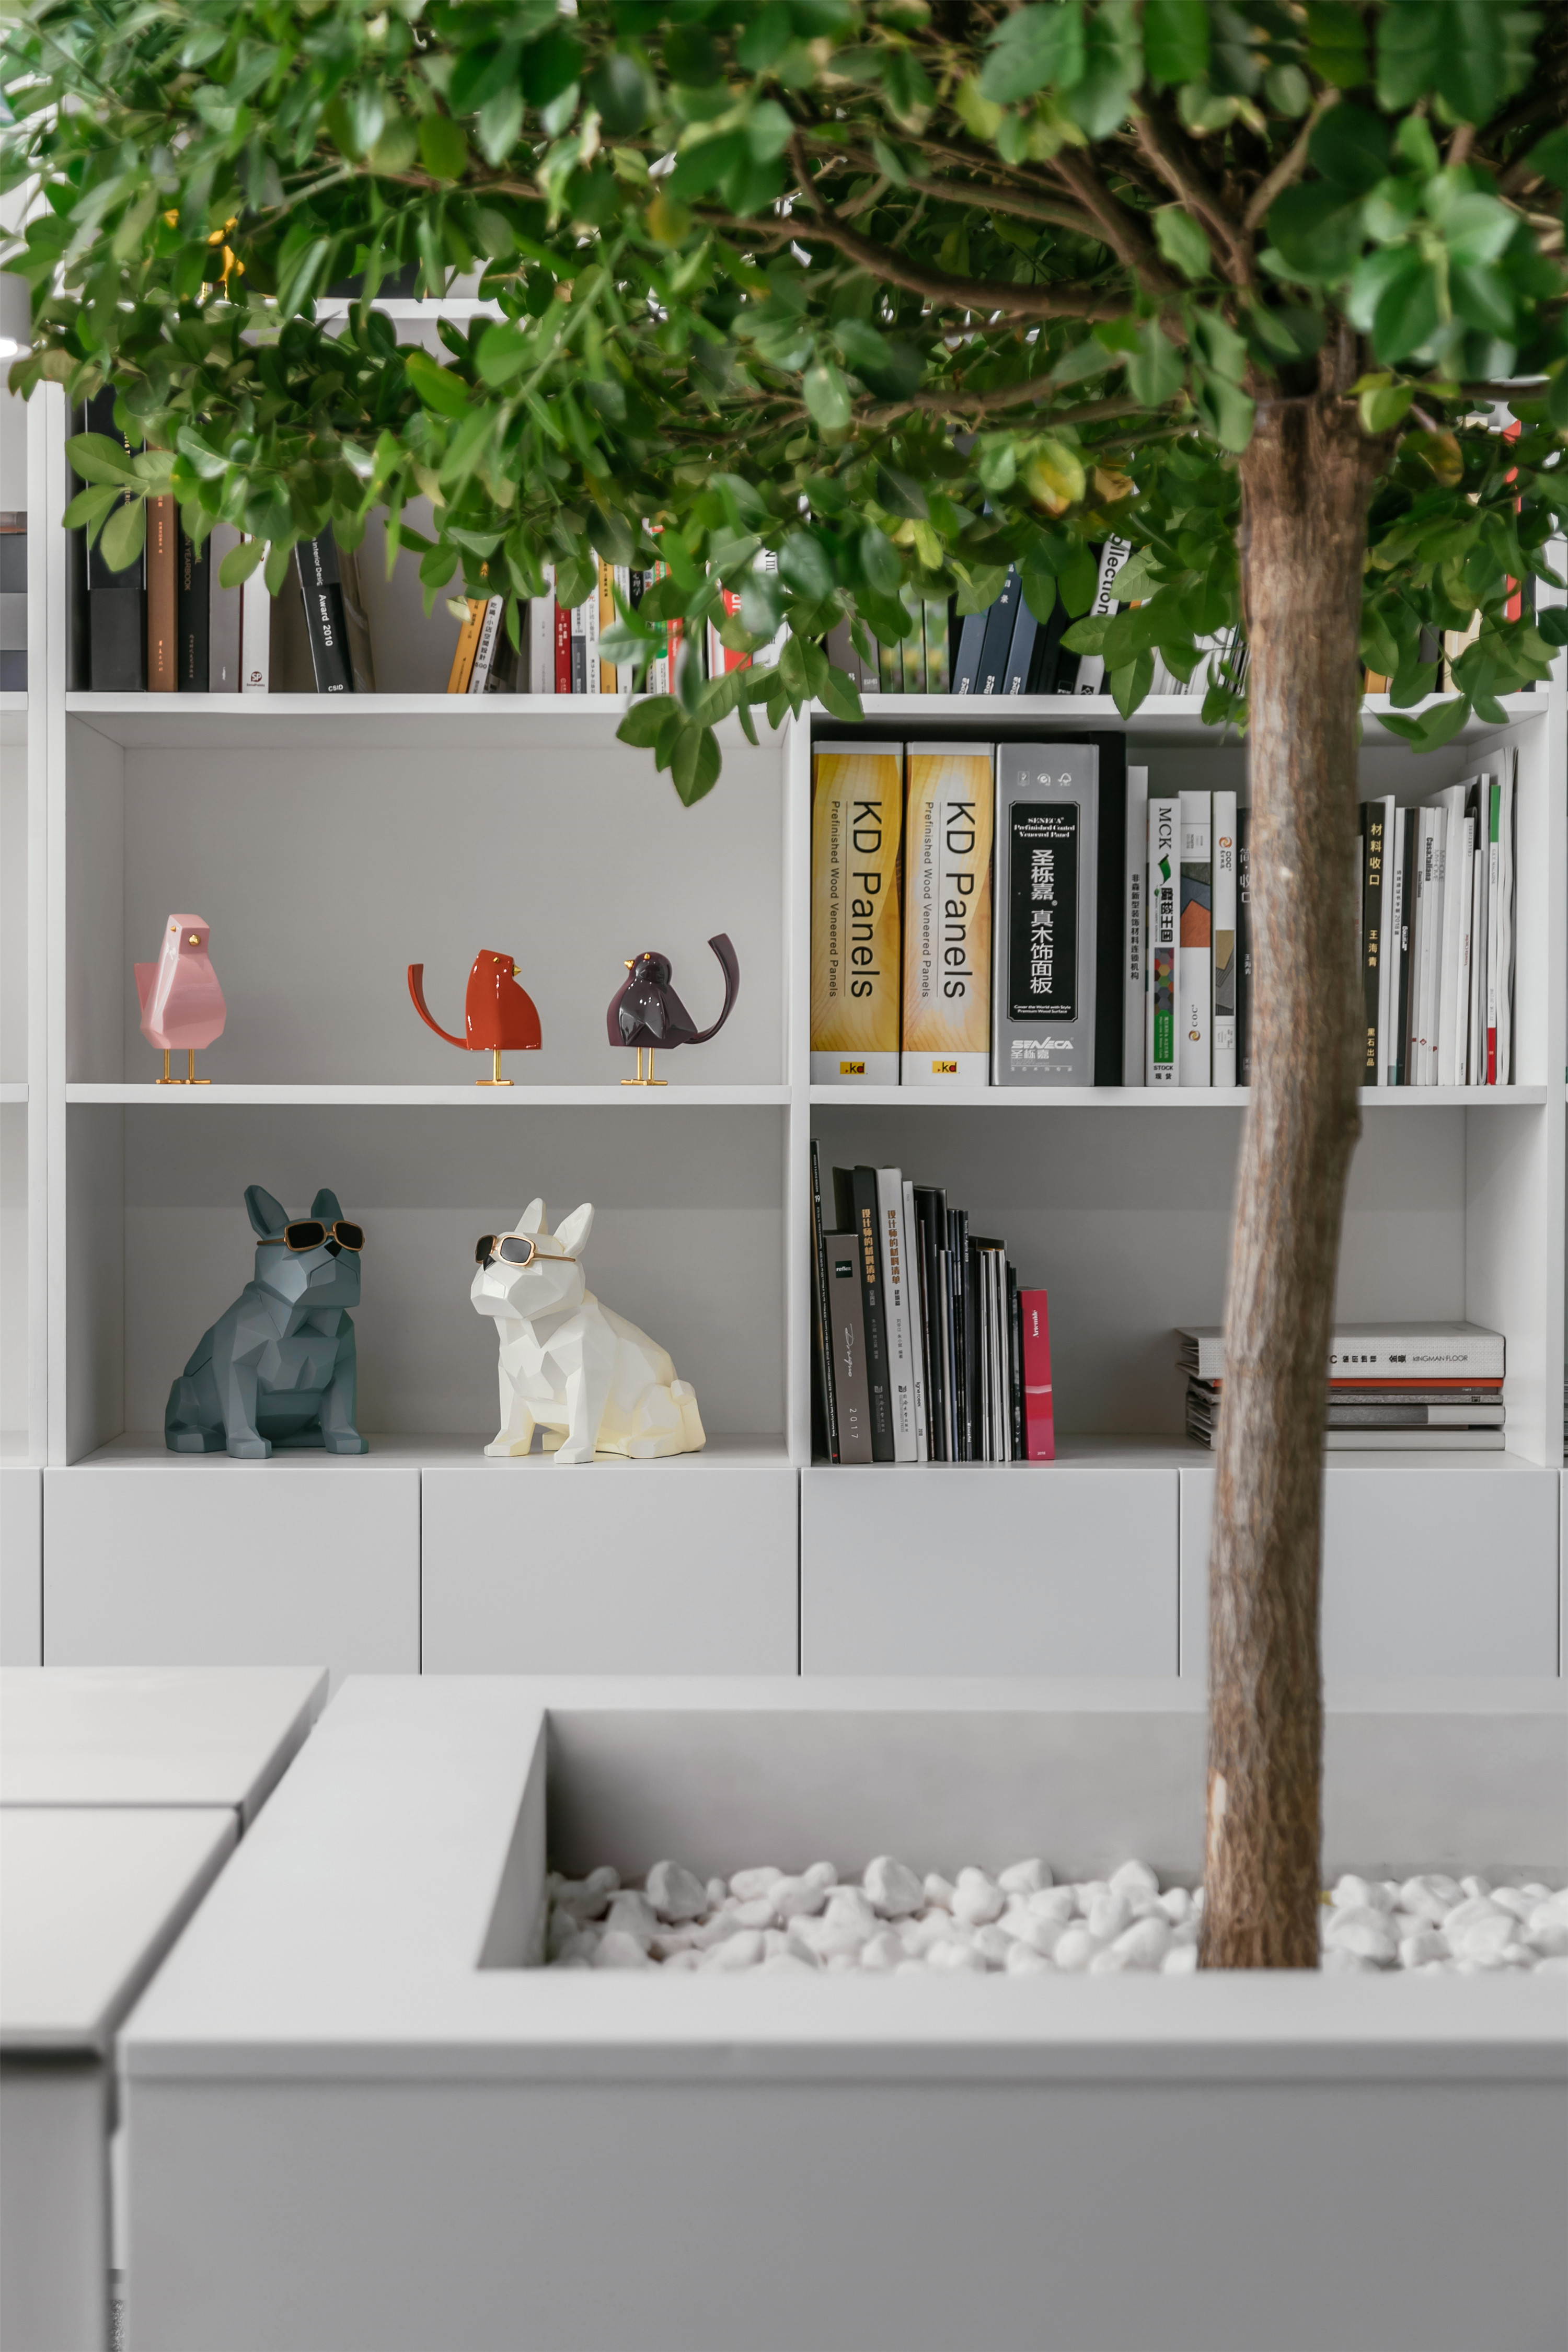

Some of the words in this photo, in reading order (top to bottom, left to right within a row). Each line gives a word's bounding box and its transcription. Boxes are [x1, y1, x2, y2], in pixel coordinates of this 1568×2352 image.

[312, 542, 323, 567] Interior
[1097, 533, 1125, 615] ollection
[319, 594, 330, 616] Award
[322, 624, 333, 647] 2010
[831, 801, 840, 863] Prefinished
[853, 801, 882, 854] KD
[924, 802, 934, 864] Prefinished
[947, 802, 976, 855] KD
[1159, 807, 1172, 850] MCK
[1368, 823, 1383, 886] 材料收口
[830, 867, 839, 898] Wood
[923, 868, 933, 900] Wood
[829, 903, 839, 955] Veneered
[851, 872, 882, 998] Panels
[922, 904, 932, 956] Veneered
[944, 873, 975, 998] Panels
[1160, 887, 1174, 943] 魔毯王国
[1030, 909, 1054, 994] 真木饰面板
[1367, 930, 1379, 967] 王海青
[829, 960, 839, 997] Panels
[921, 960, 932, 998] Panels
[850, 1063, 865, 1074] kd
[942, 1062, 957, 1073] kd
[1365, 1028, 1376, 1067] 黑石出品
[861, 1208, 877, 1283] 设计师的材料清单
[887, 1209, 901, 1284] 设计师的材料清单
[849, 1408, 859, 1439] 2017
